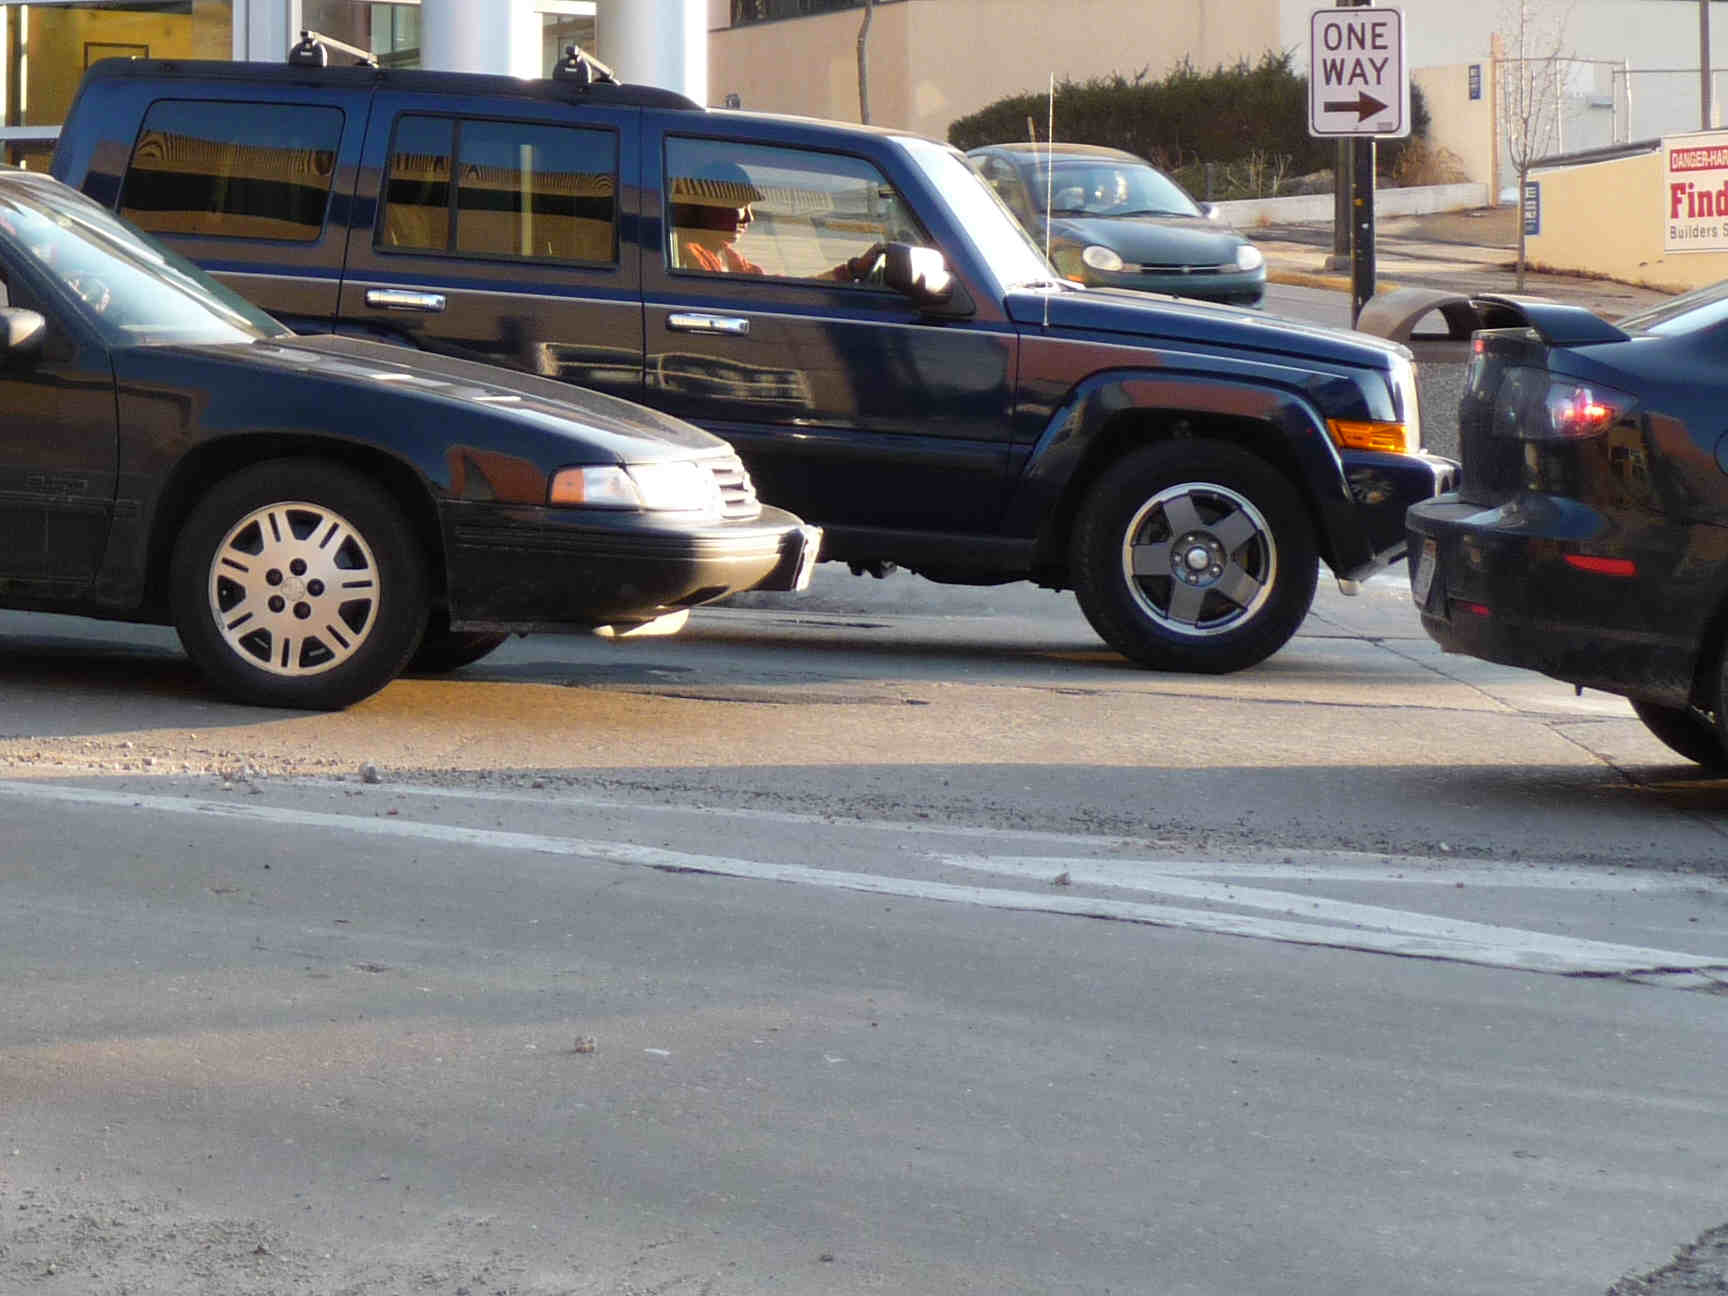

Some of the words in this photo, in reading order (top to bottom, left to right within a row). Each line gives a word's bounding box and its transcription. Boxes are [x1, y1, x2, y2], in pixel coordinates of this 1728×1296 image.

[1323, 22, 1389, 51] ONE
[1322, 57, 1390, 86] WAY
[1670, 224, 1718, 240] Builders
